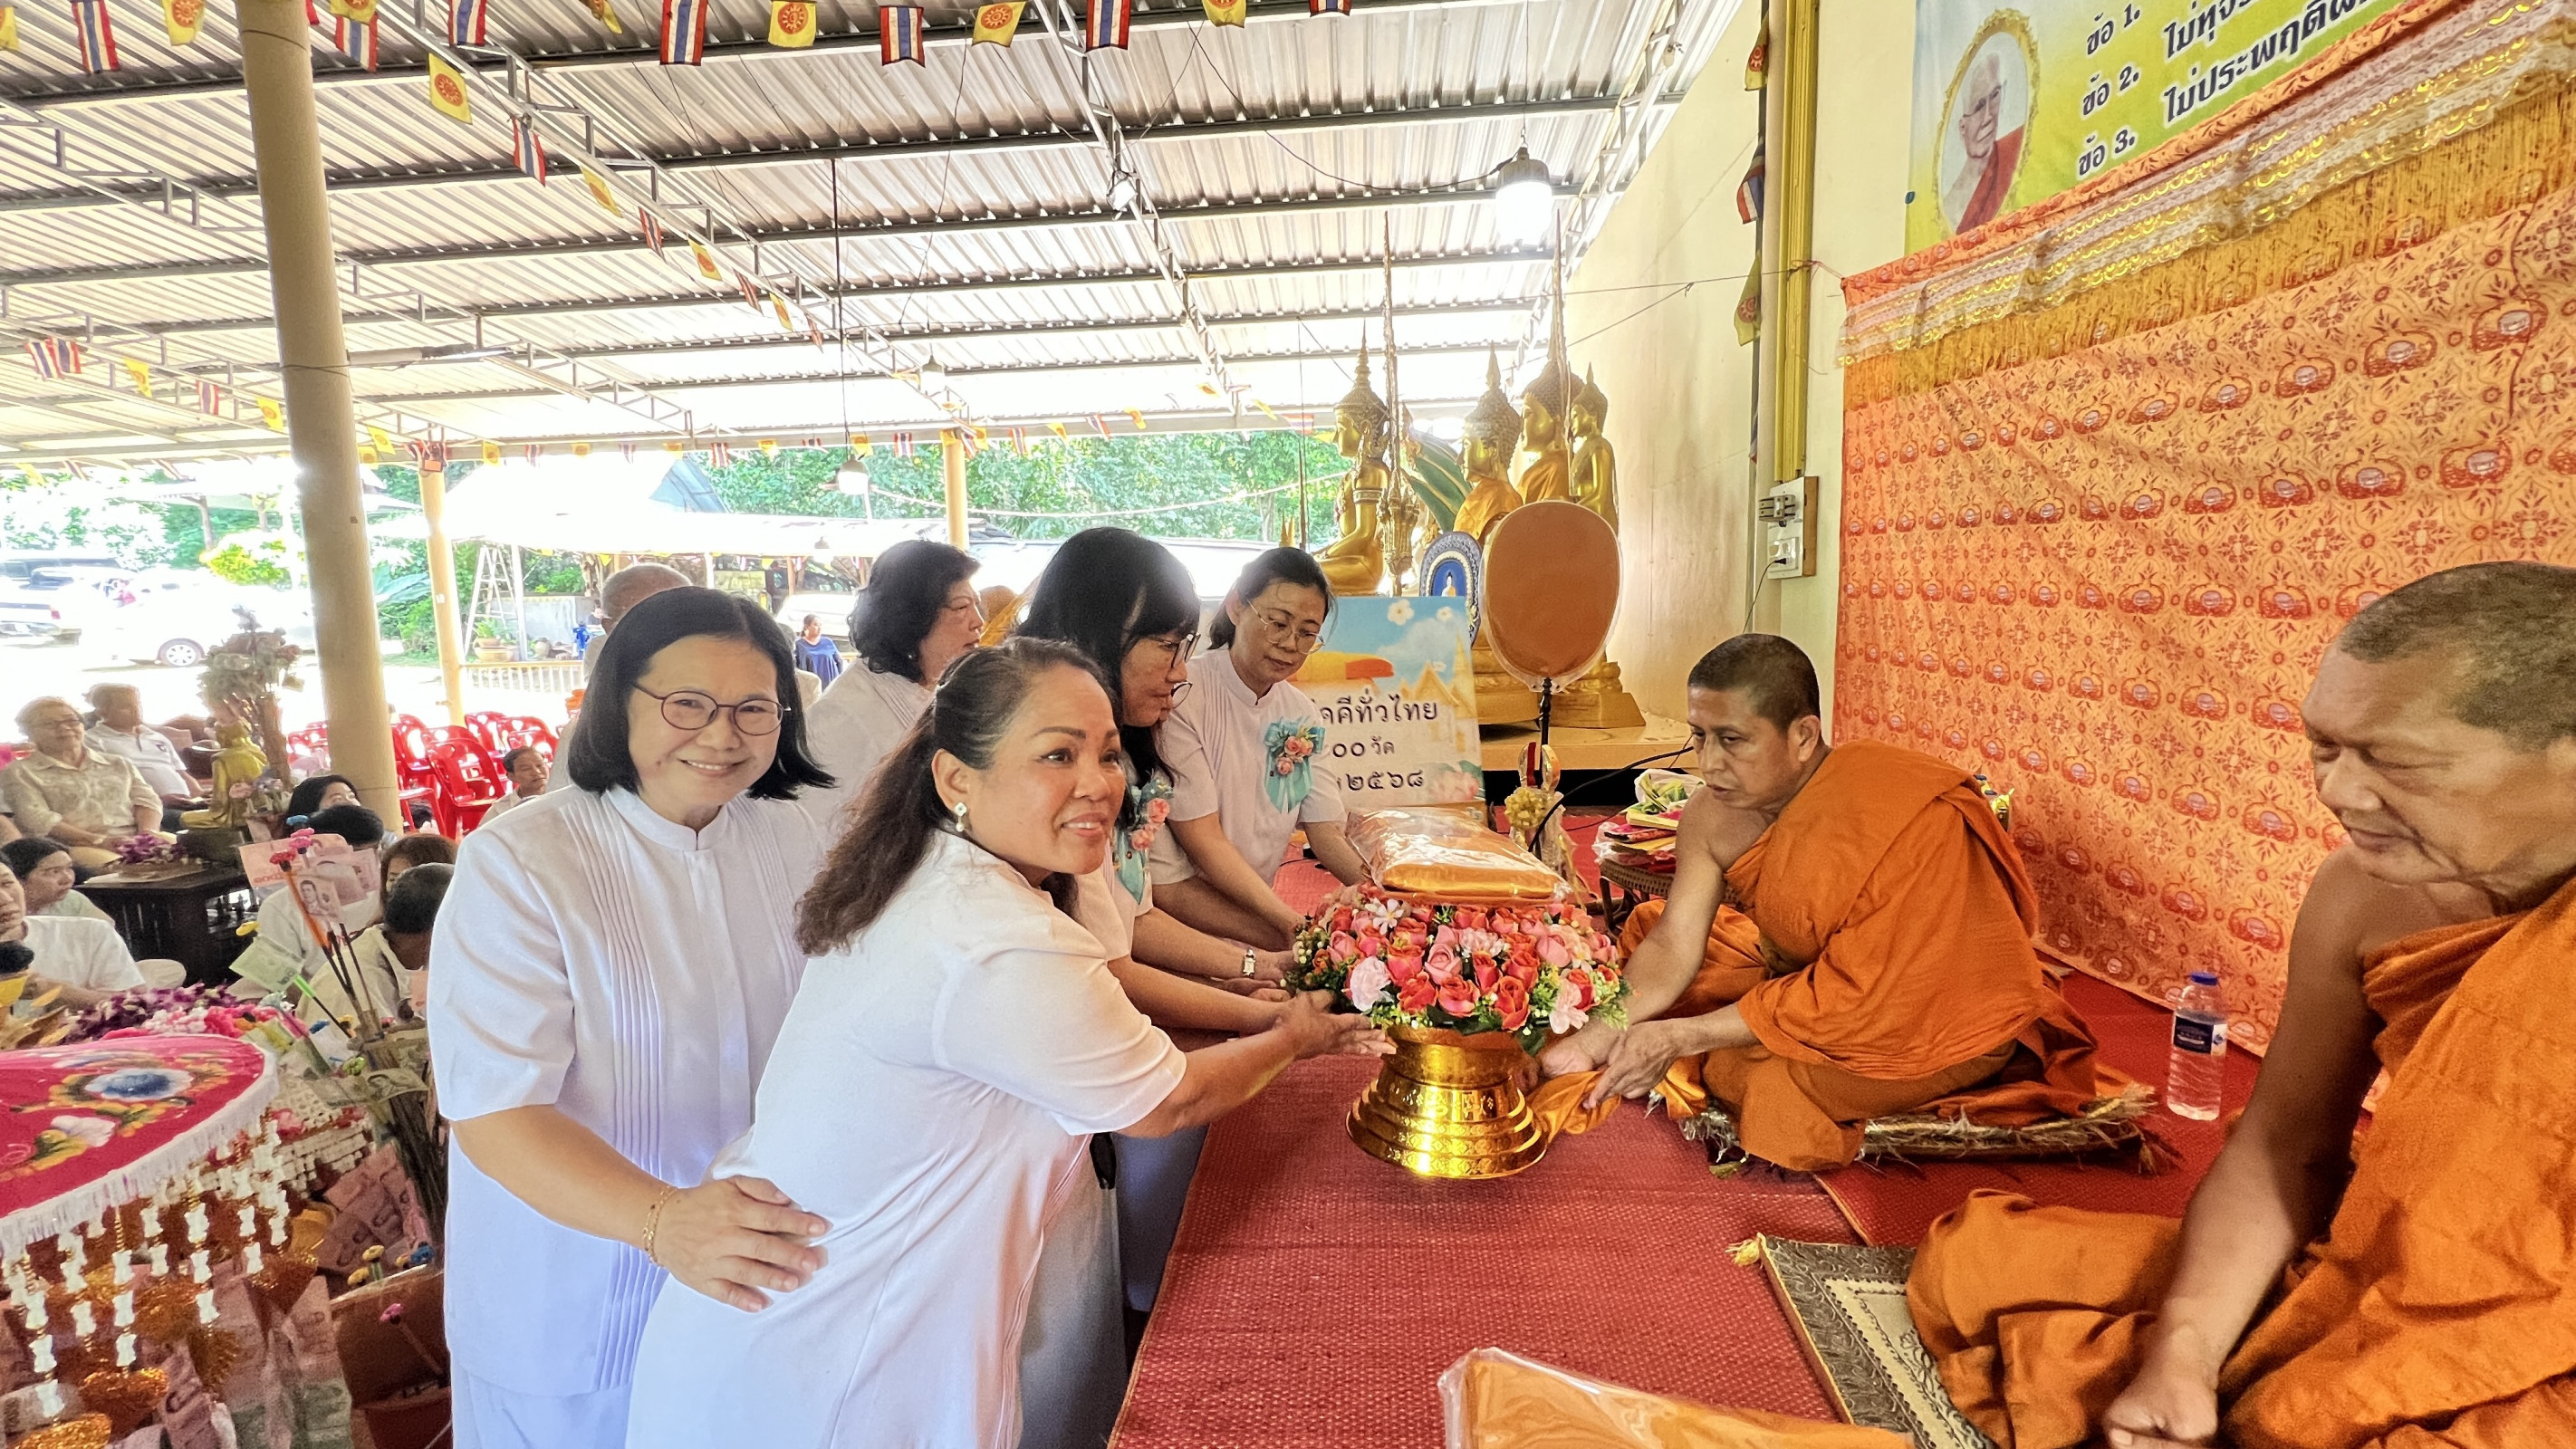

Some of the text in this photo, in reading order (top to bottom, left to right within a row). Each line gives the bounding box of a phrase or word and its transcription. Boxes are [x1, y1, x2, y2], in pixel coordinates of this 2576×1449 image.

[2087, 3, 2140, 55] ข้อ 1.
[2083, 0, 2253, 116] ข้อ 2. ไม่ทุจ
[2079, 135, 2106, 176] ข้อ
[2114, 129, 2136, 154] 3.
[1345, 770, 1424, 792] ๒๕๖๘
